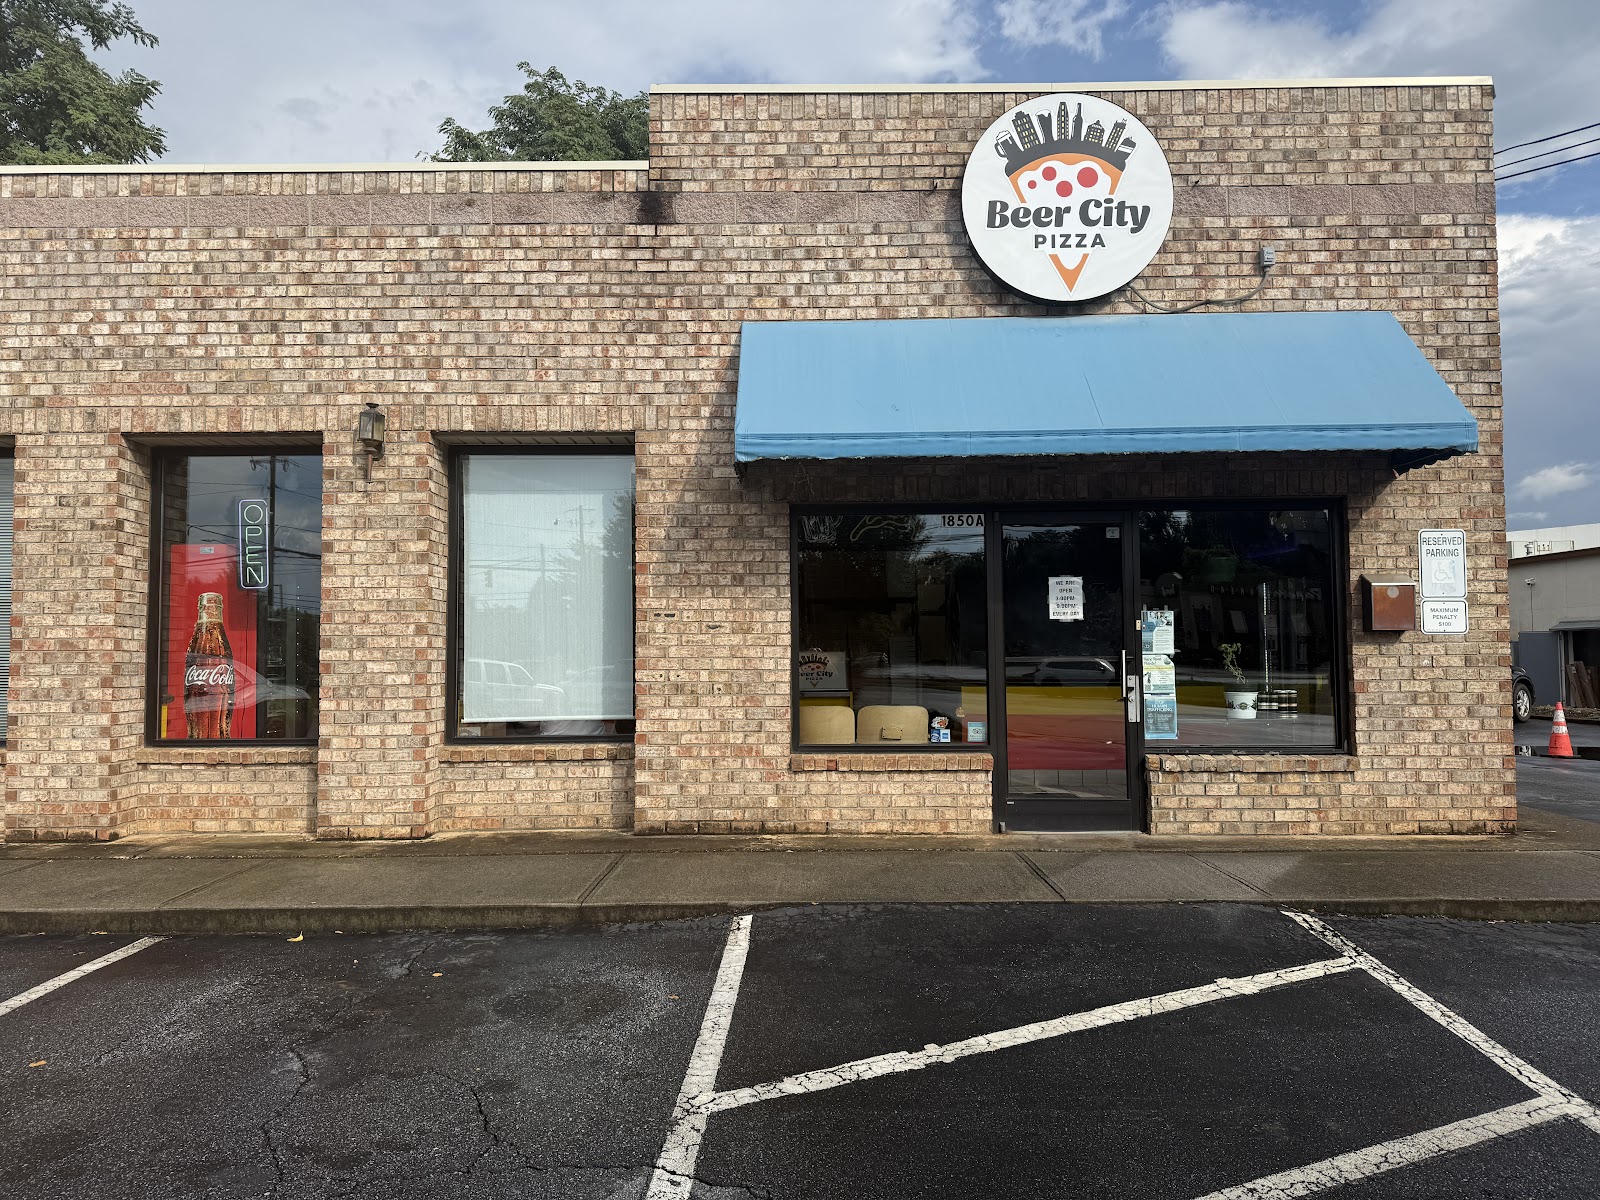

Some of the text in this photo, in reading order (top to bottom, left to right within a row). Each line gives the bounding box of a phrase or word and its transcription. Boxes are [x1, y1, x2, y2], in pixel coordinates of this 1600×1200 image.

[986, 197, 1151, 234] Beer City
[1034, 233, 1106, 249] PIZZA
[941, 514, 984, 527] 1850A
[243, 504, 264, 584] OPEN
[1422, 536, 1462, 546] RESERVED
[1425, 548, 1459, 557] PARKING
[185, 664, 234, 686] Coca-Cola
[816, 670, 834, 678] City
